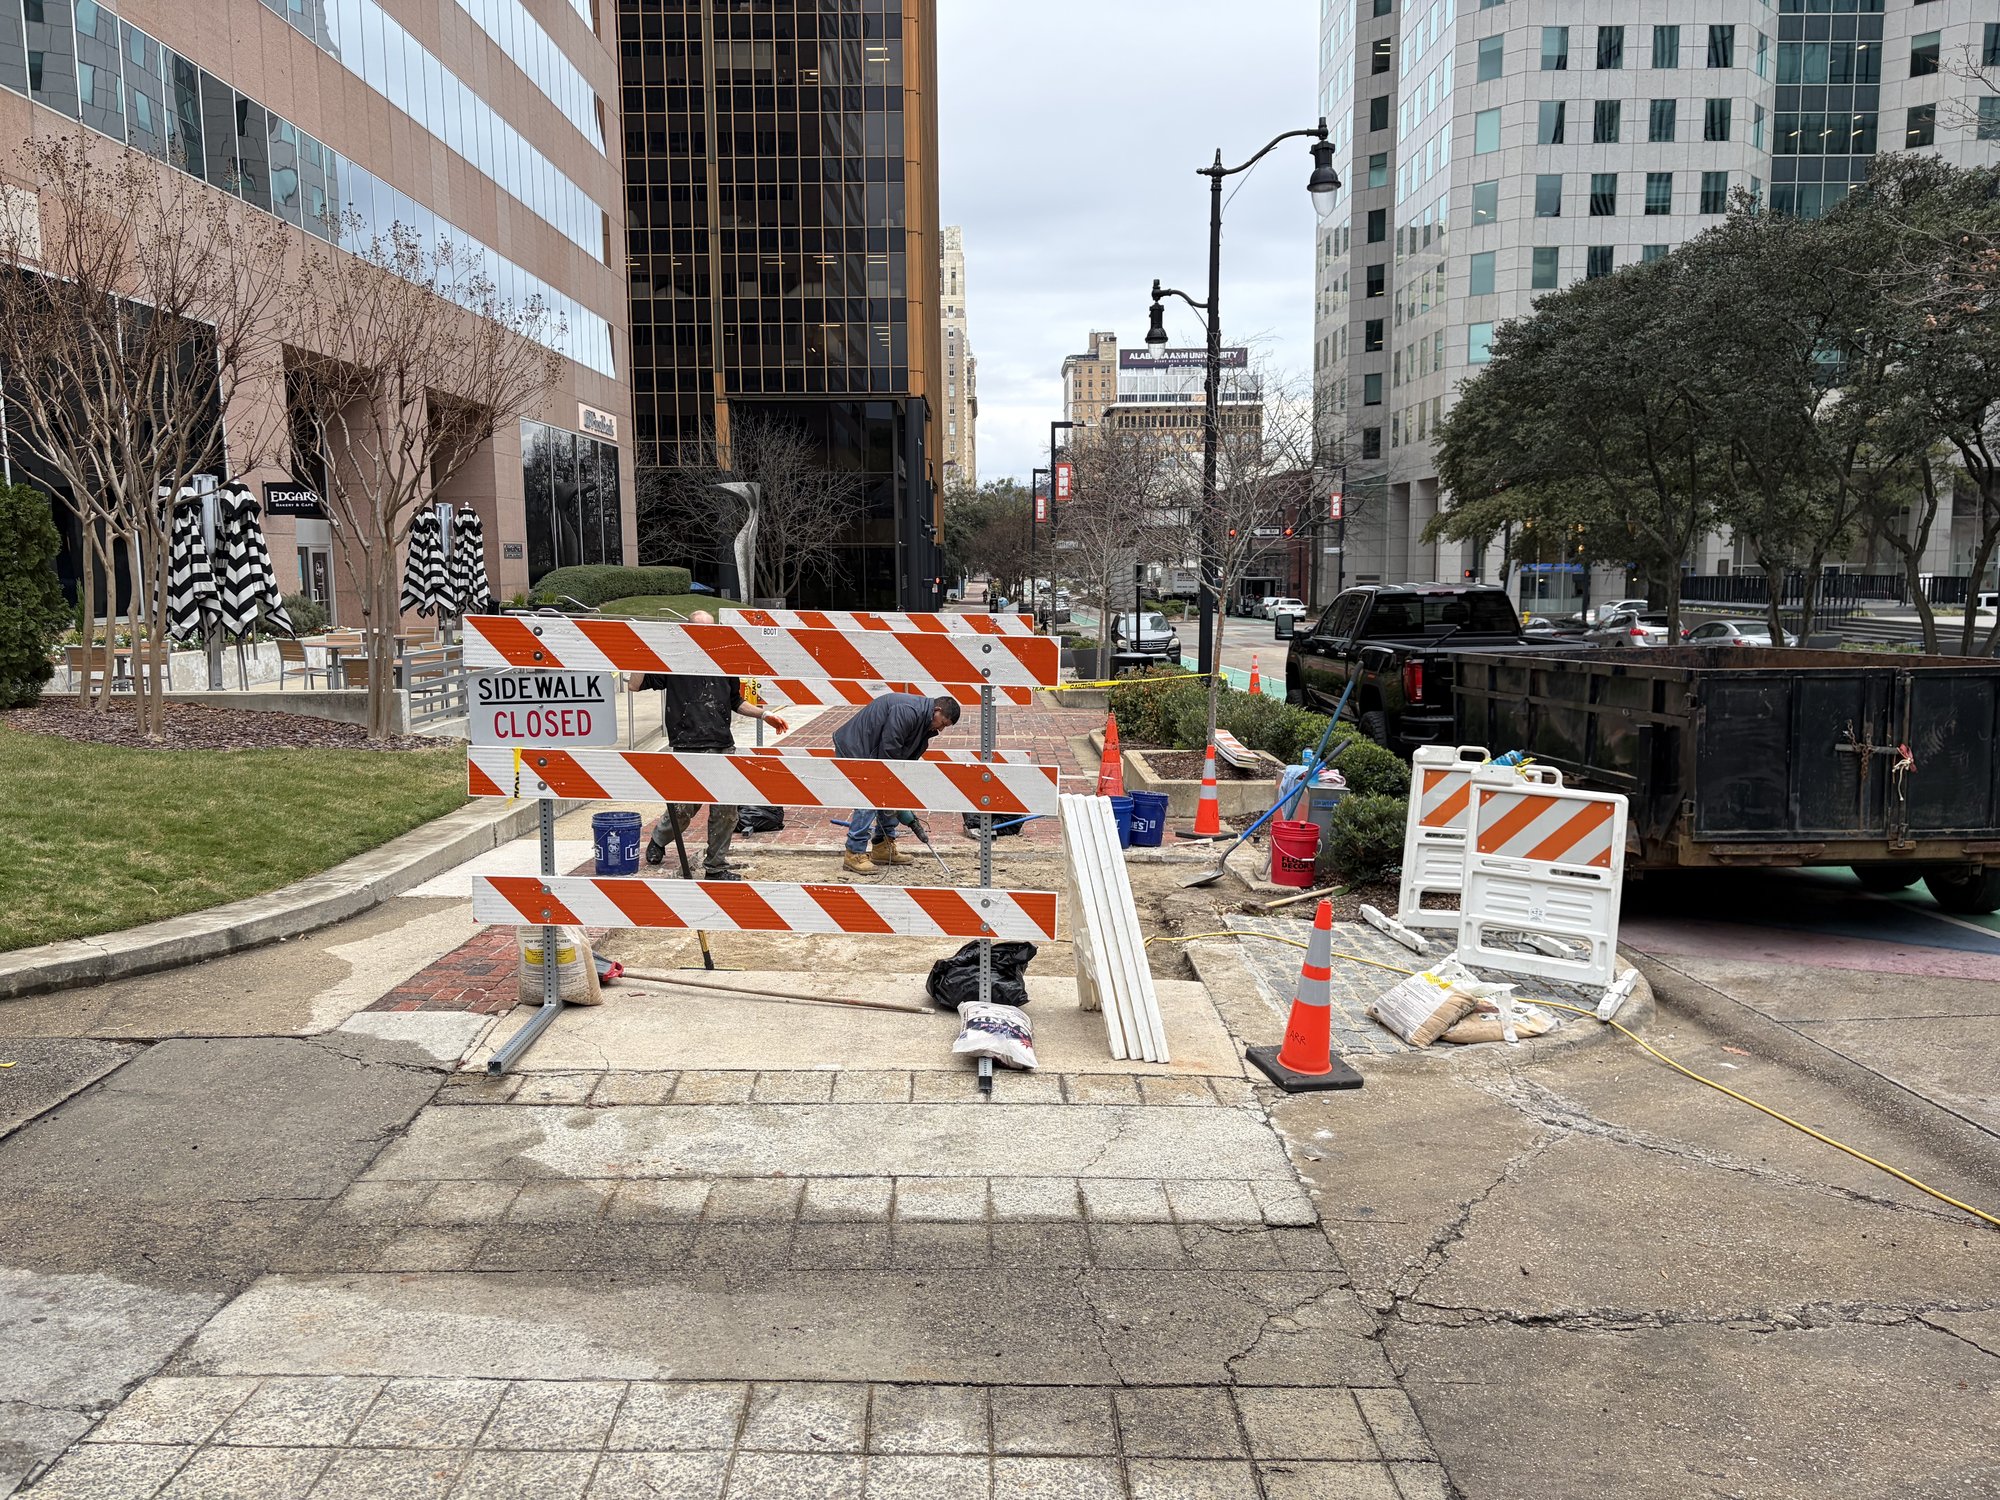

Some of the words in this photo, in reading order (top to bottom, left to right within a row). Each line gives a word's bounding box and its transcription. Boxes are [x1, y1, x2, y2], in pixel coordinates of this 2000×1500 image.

[1129, 352, 1169, 360] ALABA
[1189, 351, 1238, 359] UNIVSITY
[478, 675, 602, 700] SIDEWALK
[494, 709, 592, 739] CLOSED
